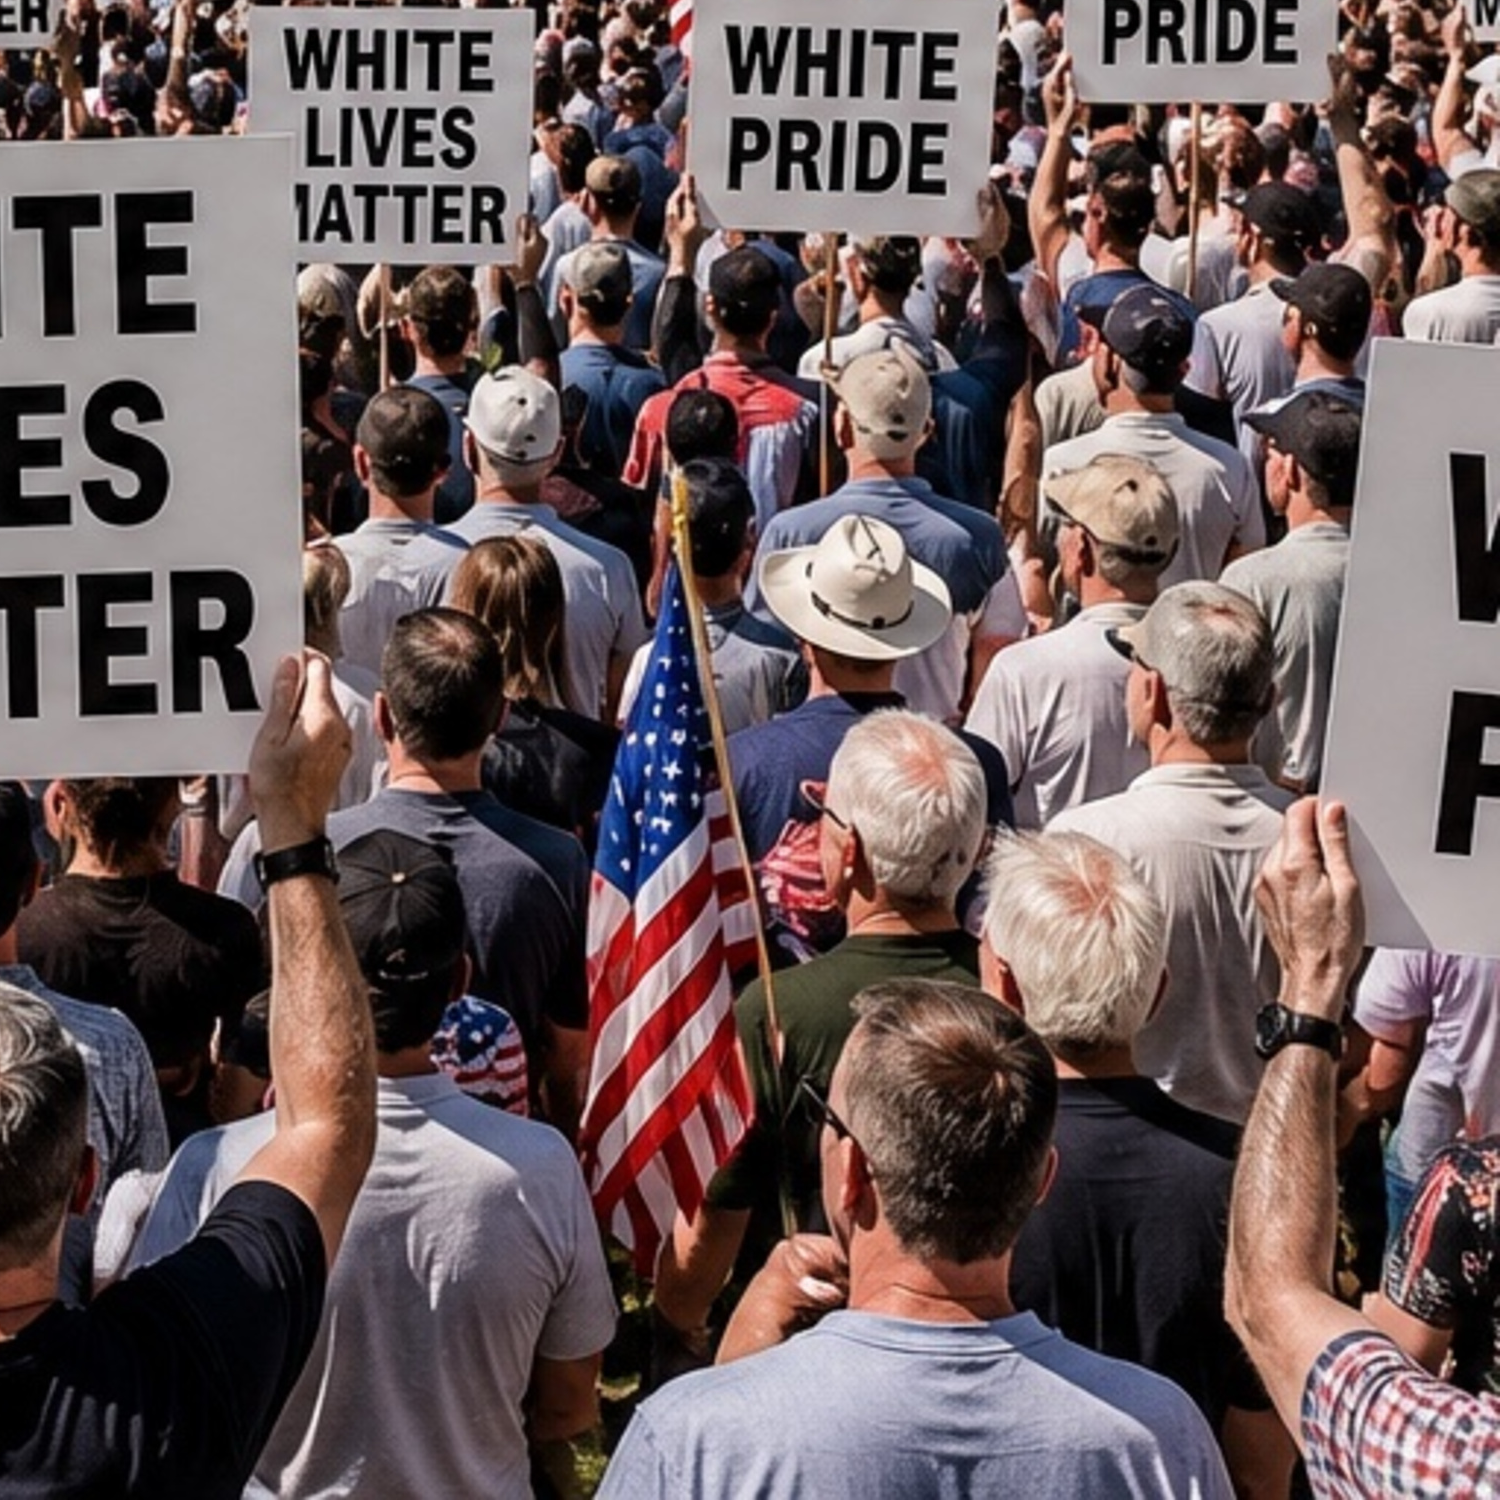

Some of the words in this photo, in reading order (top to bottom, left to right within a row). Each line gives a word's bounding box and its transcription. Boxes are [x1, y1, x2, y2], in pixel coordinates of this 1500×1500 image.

[284, 28, 493, 92] WHITE
[725, 25, 958, 100] WHITE
[307, 107, 476, 169] LIVES
[728, 117, 948, 196] PRIDE
